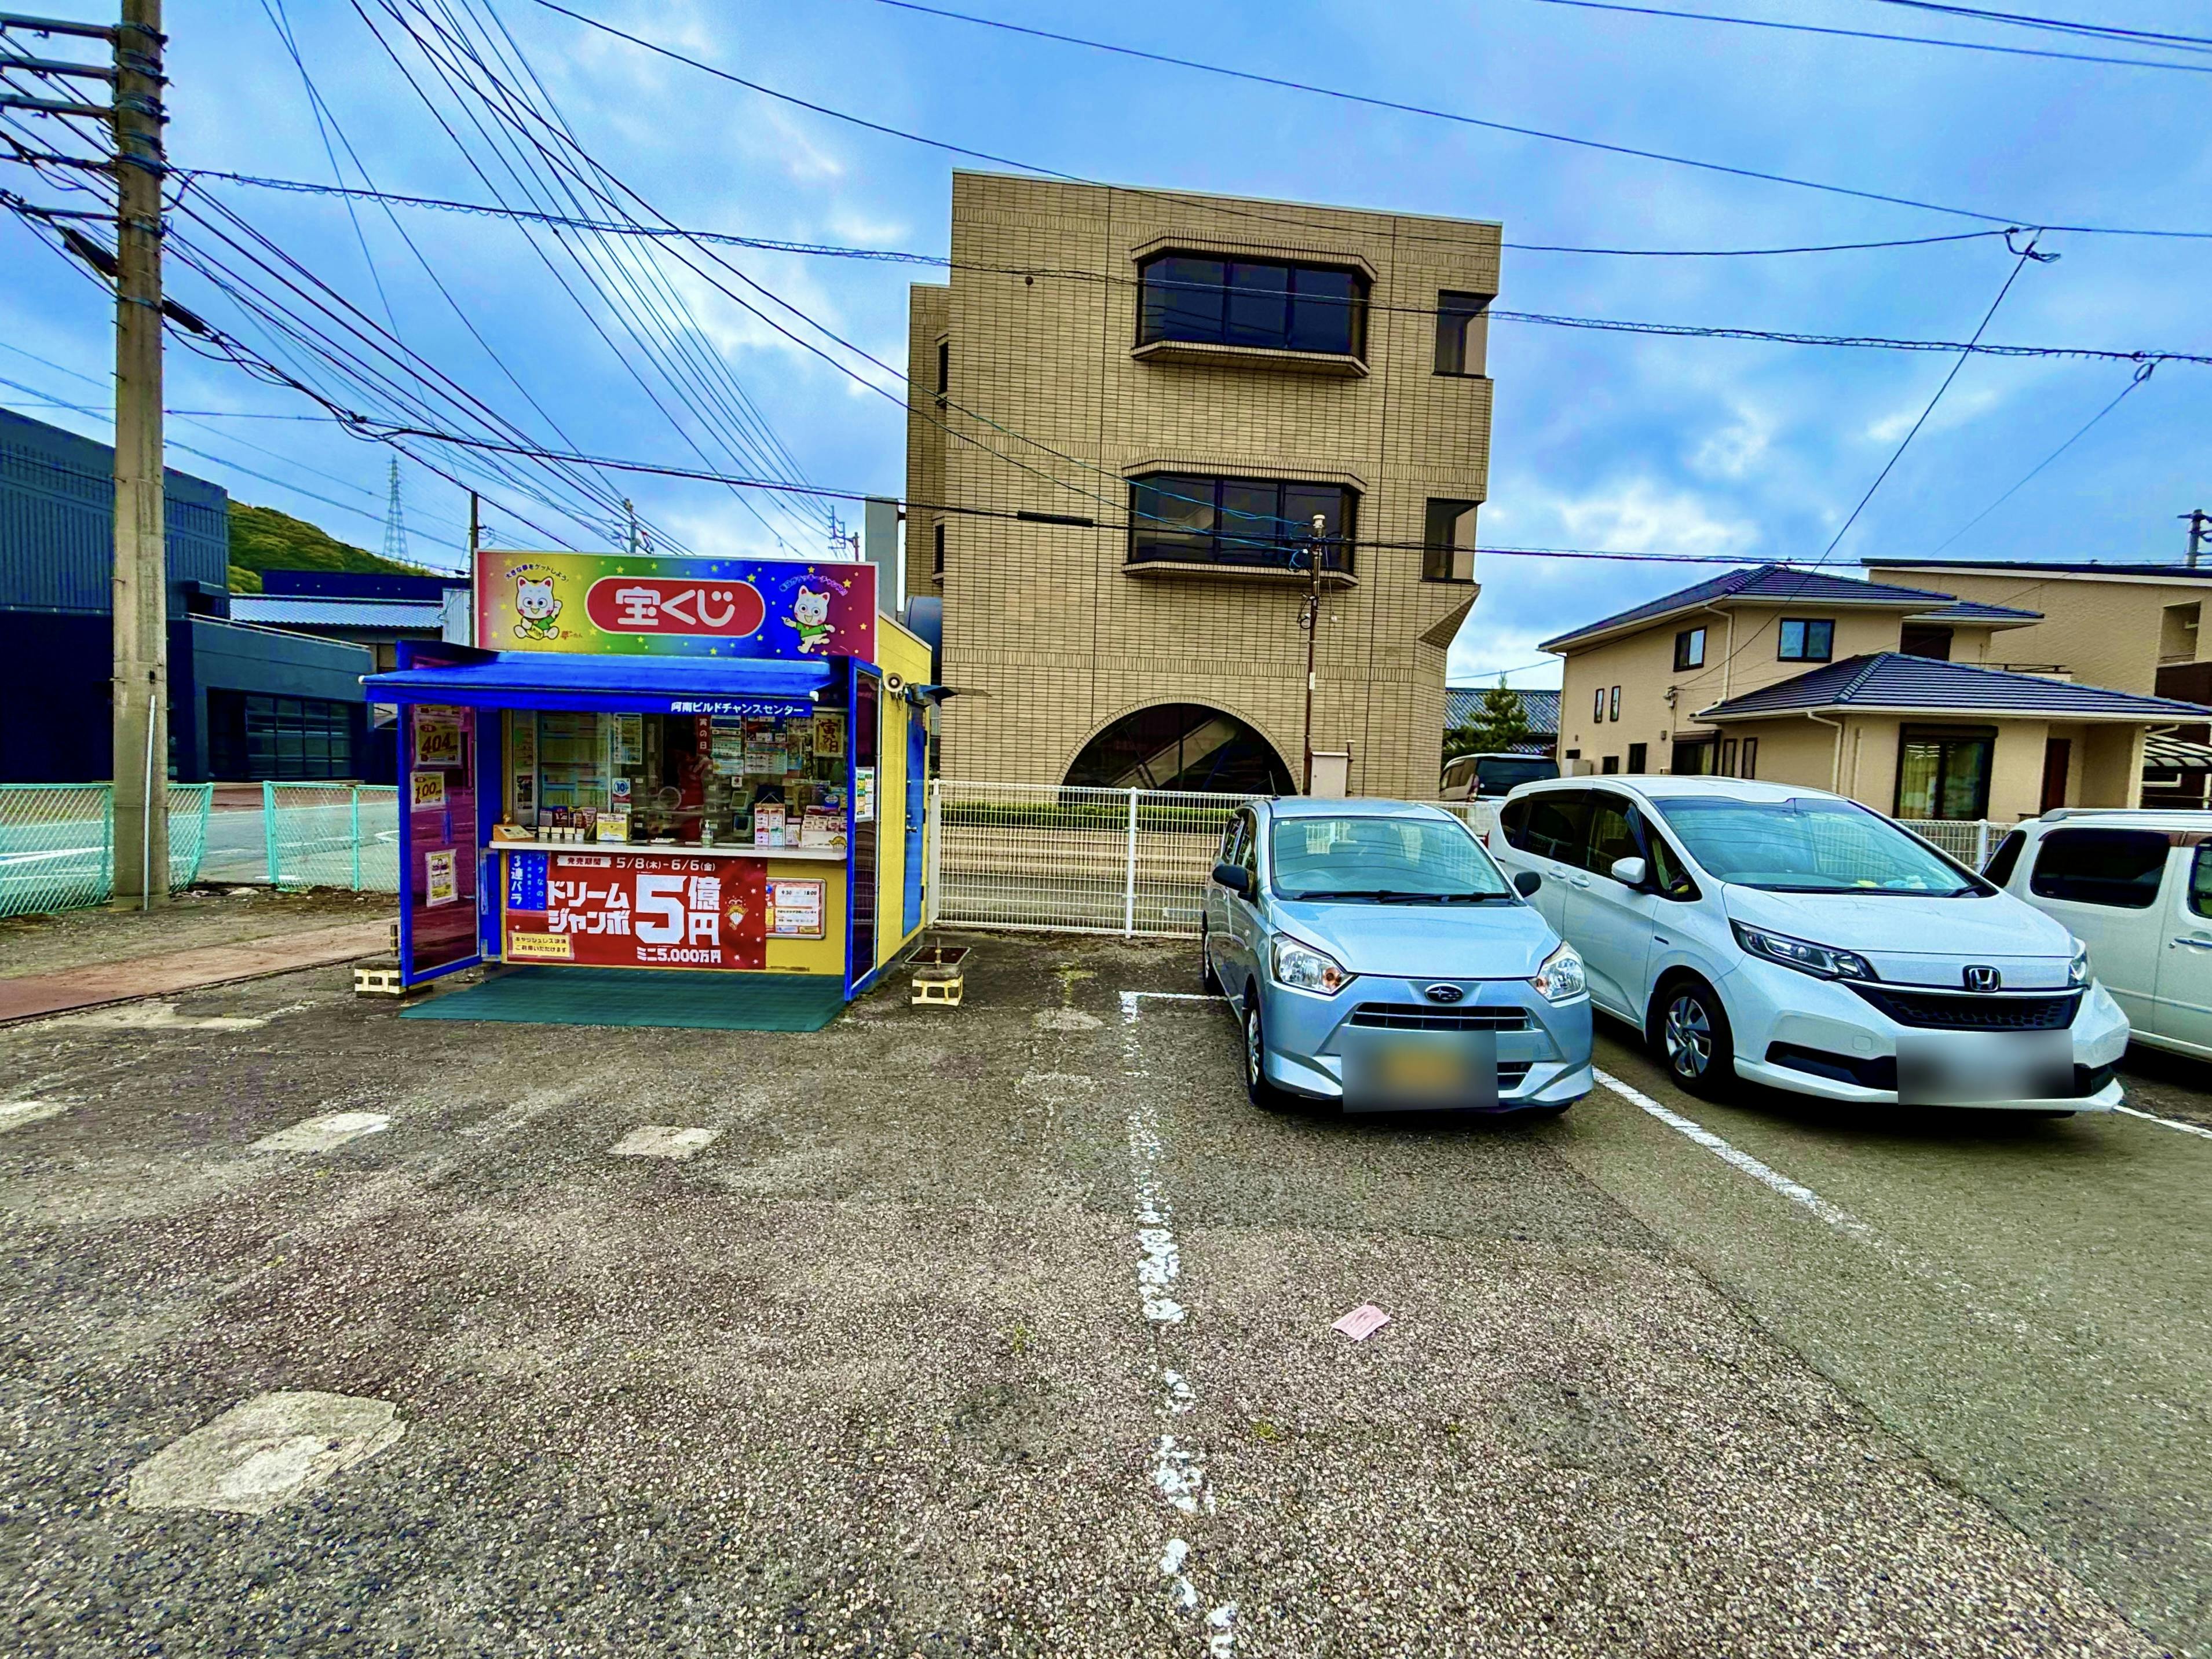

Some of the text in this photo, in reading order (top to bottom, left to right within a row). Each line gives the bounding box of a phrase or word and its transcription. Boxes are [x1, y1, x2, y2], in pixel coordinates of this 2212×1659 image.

[615, 586, 735, 627] 宝くじ
[671, 701, 804, 715] 阿南ビルドチャンスセンター
[566, 857, 602, 865] 発売期間
[511, 855, 523, 905] 3連バラ
[547, 880, 631, 909] ドリーム
[548, 908, 631, 936] ジャンボ
